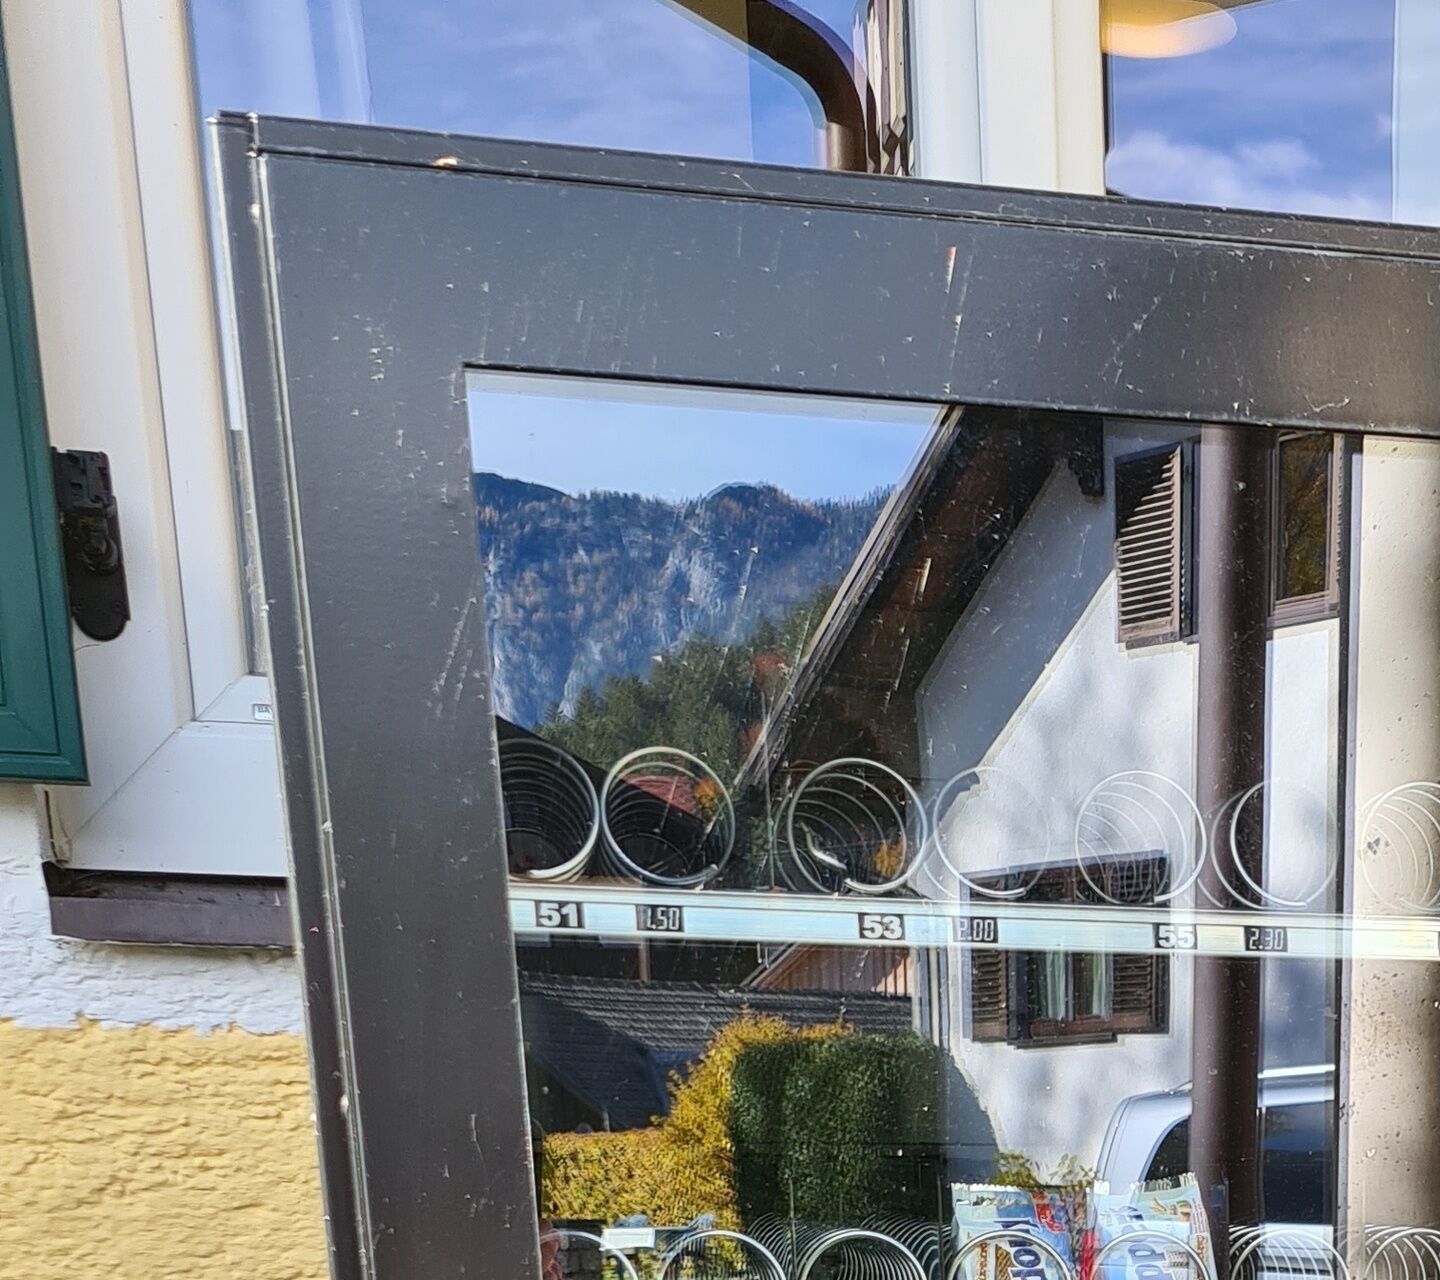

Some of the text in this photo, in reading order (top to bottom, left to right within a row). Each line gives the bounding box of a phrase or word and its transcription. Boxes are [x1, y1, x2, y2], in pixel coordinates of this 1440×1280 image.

[538, 903, 577, 928] 51
[863, 916, 903, 940] 53
[1158, 927, 1285, 950] 55 2.30
